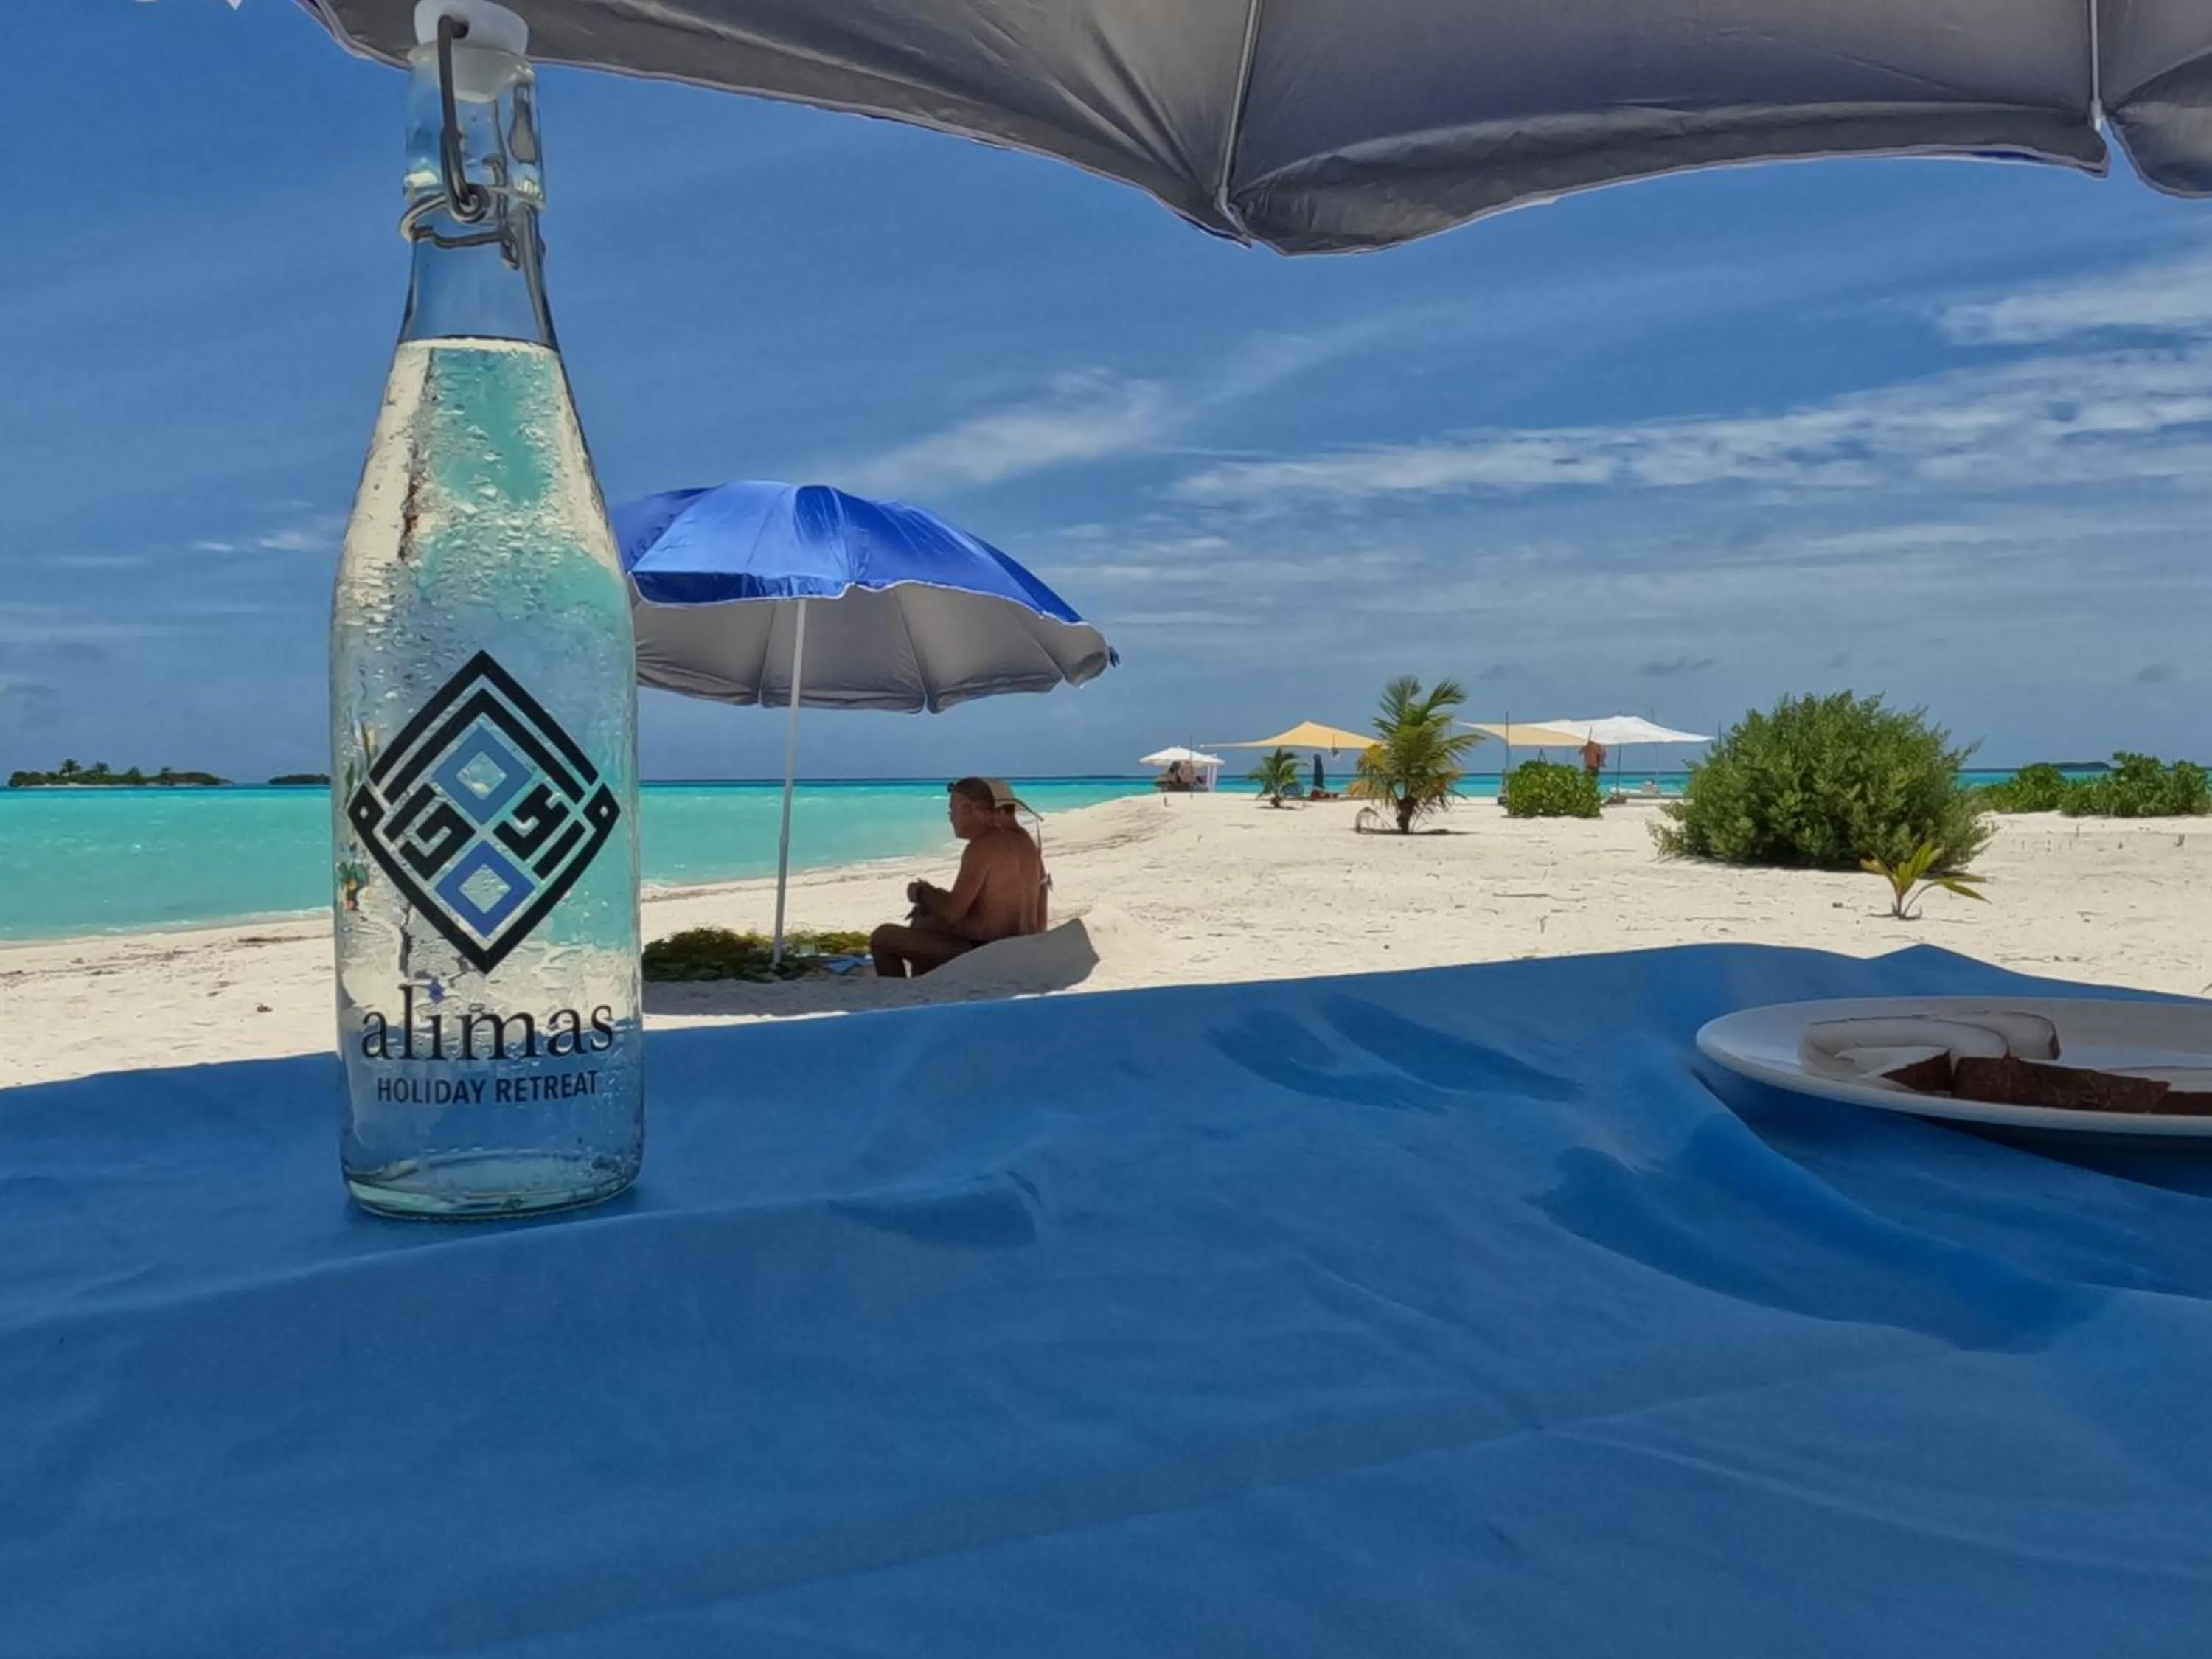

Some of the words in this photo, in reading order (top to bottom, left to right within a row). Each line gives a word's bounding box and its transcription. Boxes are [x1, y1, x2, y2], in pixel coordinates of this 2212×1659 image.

[361, 984, 614, 1061] alimas
[377, 1077, 486, 1105] HOLIDAY
[495, 1070, 598, 1103] RETREAT
